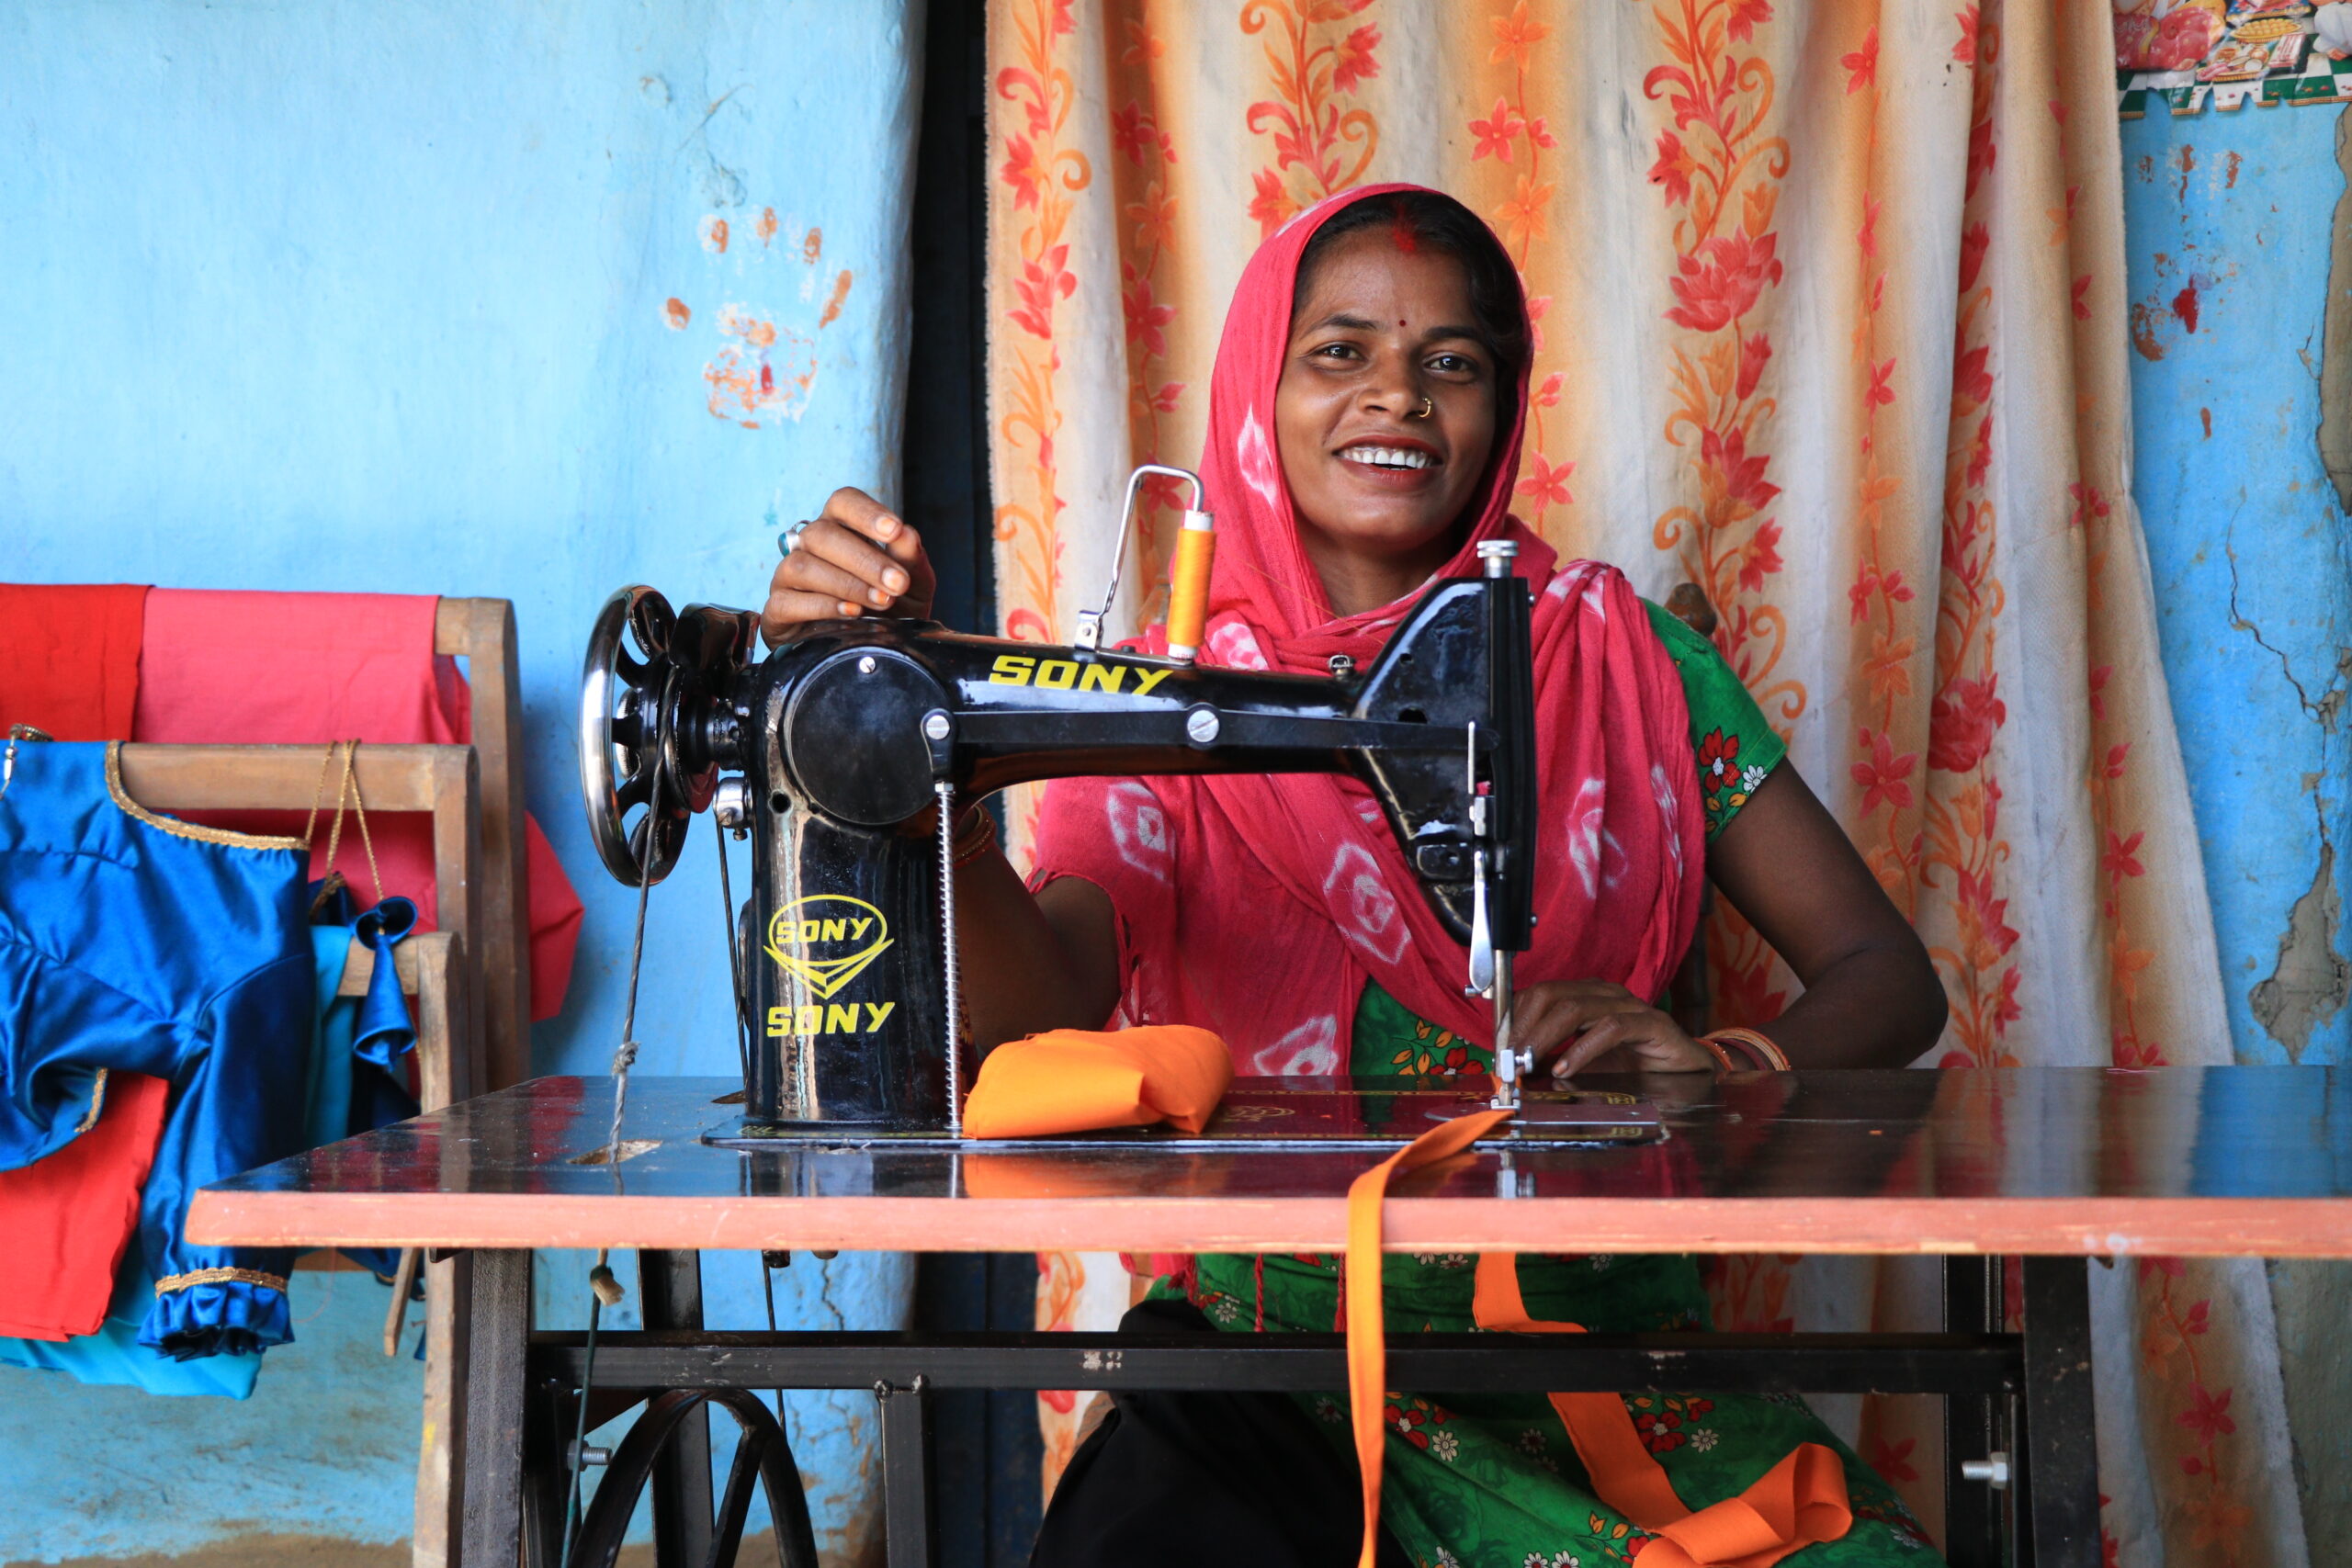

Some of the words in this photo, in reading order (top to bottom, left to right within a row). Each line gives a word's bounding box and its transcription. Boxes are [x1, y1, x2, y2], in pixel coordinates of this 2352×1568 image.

[989, 655, 1174, 695] SONY
[775, 918, 873, 943] SONY
[767, 1002, 895, 1037] SONY
